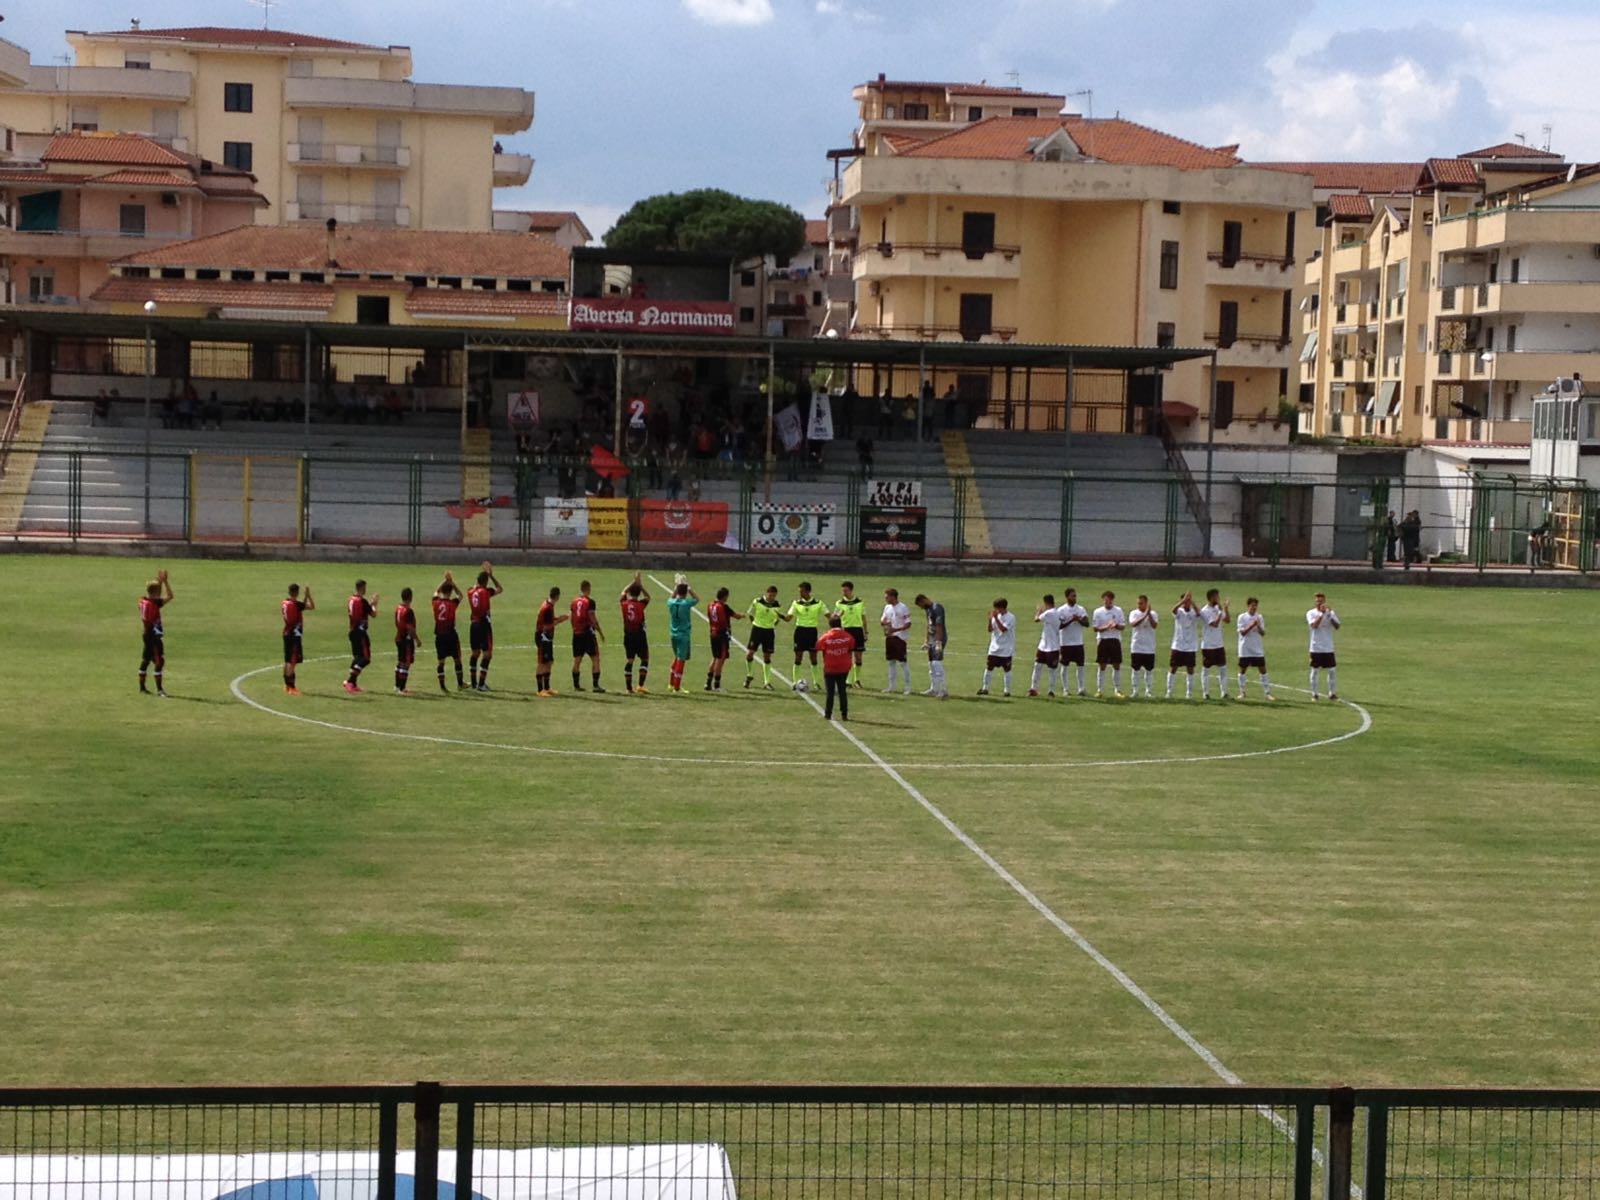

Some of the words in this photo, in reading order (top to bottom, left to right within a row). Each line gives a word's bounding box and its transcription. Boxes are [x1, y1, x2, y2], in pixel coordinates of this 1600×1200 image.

[573, 304, 634, 323] Aversa
[638, 306, 734, 328] Normanna
[630, 399, 645, 424] 2
[437, 603, 447, 621] 2
[626, 603, 635, 621] 5
